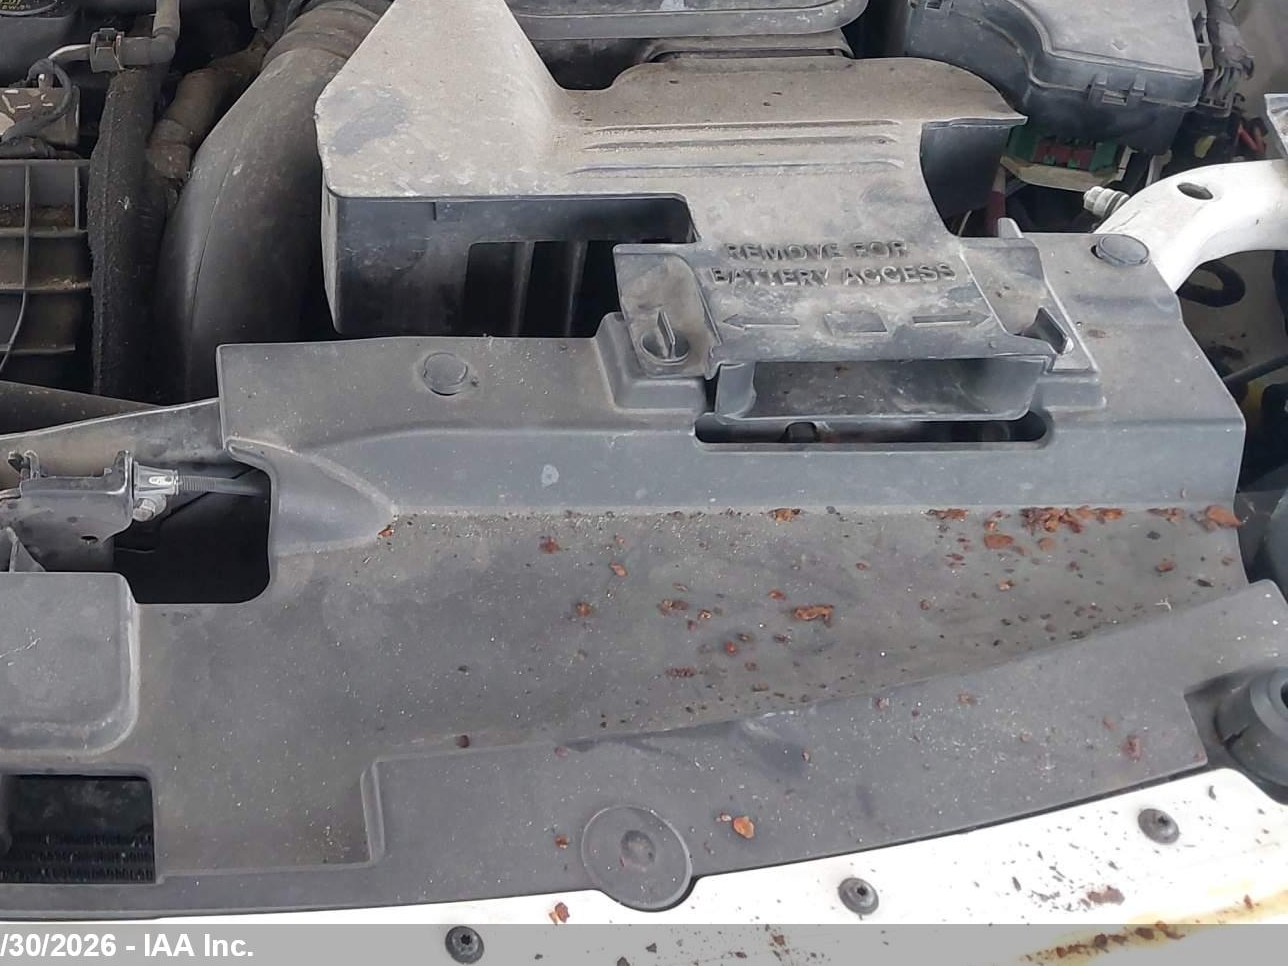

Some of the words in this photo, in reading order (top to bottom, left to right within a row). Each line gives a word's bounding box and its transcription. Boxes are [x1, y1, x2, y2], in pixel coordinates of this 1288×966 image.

[725, 242, 846, 260] REMOVE
[850, 241, 909, 259] FOR
[710, 266, 830, 285] BATTERY
[843, 262, 956, 285] ACCESS
